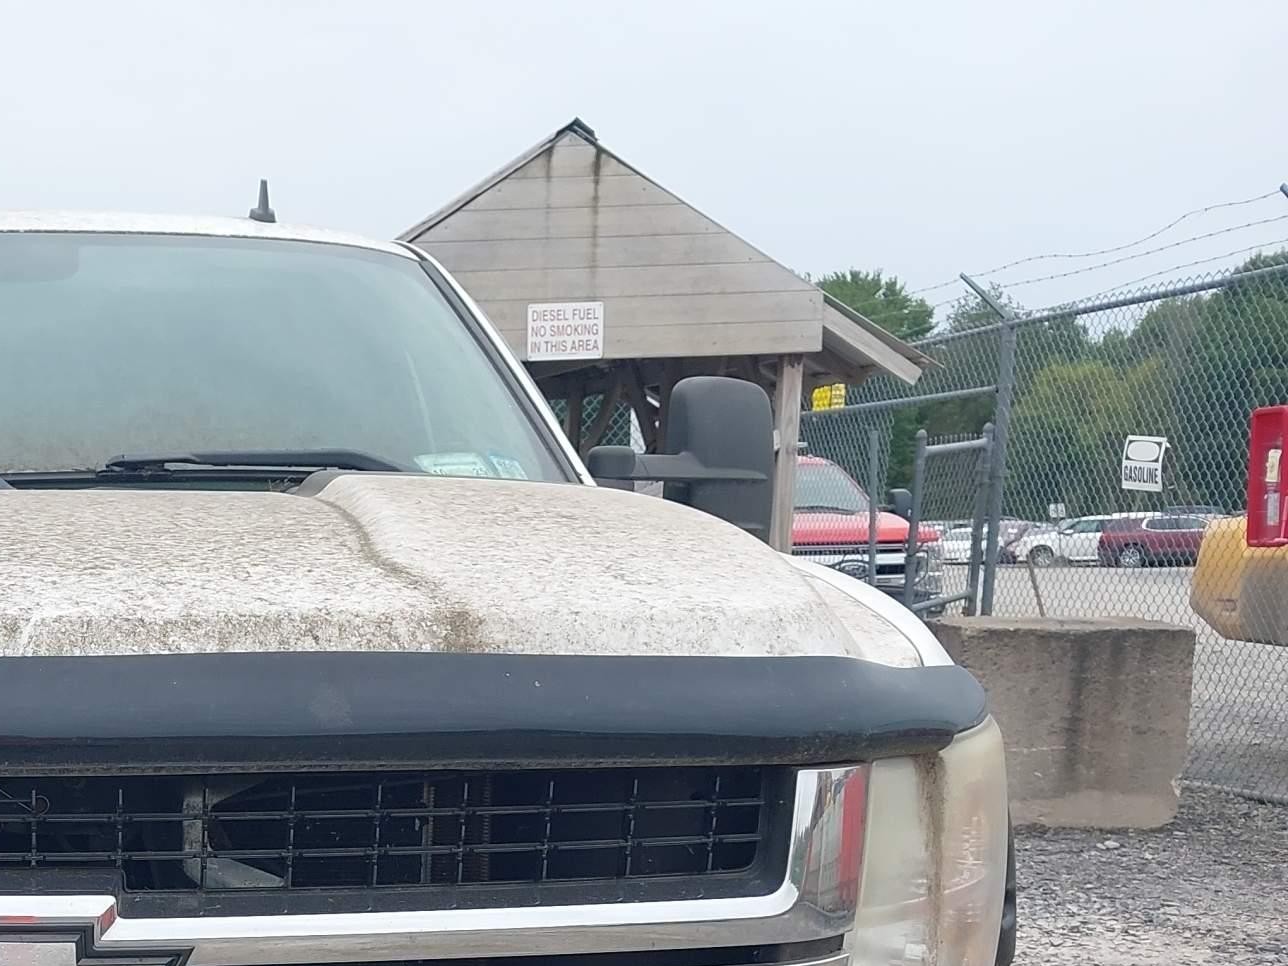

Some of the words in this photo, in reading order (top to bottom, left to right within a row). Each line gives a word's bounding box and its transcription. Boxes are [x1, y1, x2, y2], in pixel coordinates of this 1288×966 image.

[532, 309, 569, 322] DIESEL
[572, 308, 599, 321] FUEL
[531, 325, 546, 338] NO
[550, 323, 599, 337] SMOKING
[530, 341, 541, 354] IN
[543, 340, 568, 353] THIS
[569, 339, 599, 352] AREA
[1124, 465, 1159, 484] GASOLINE
